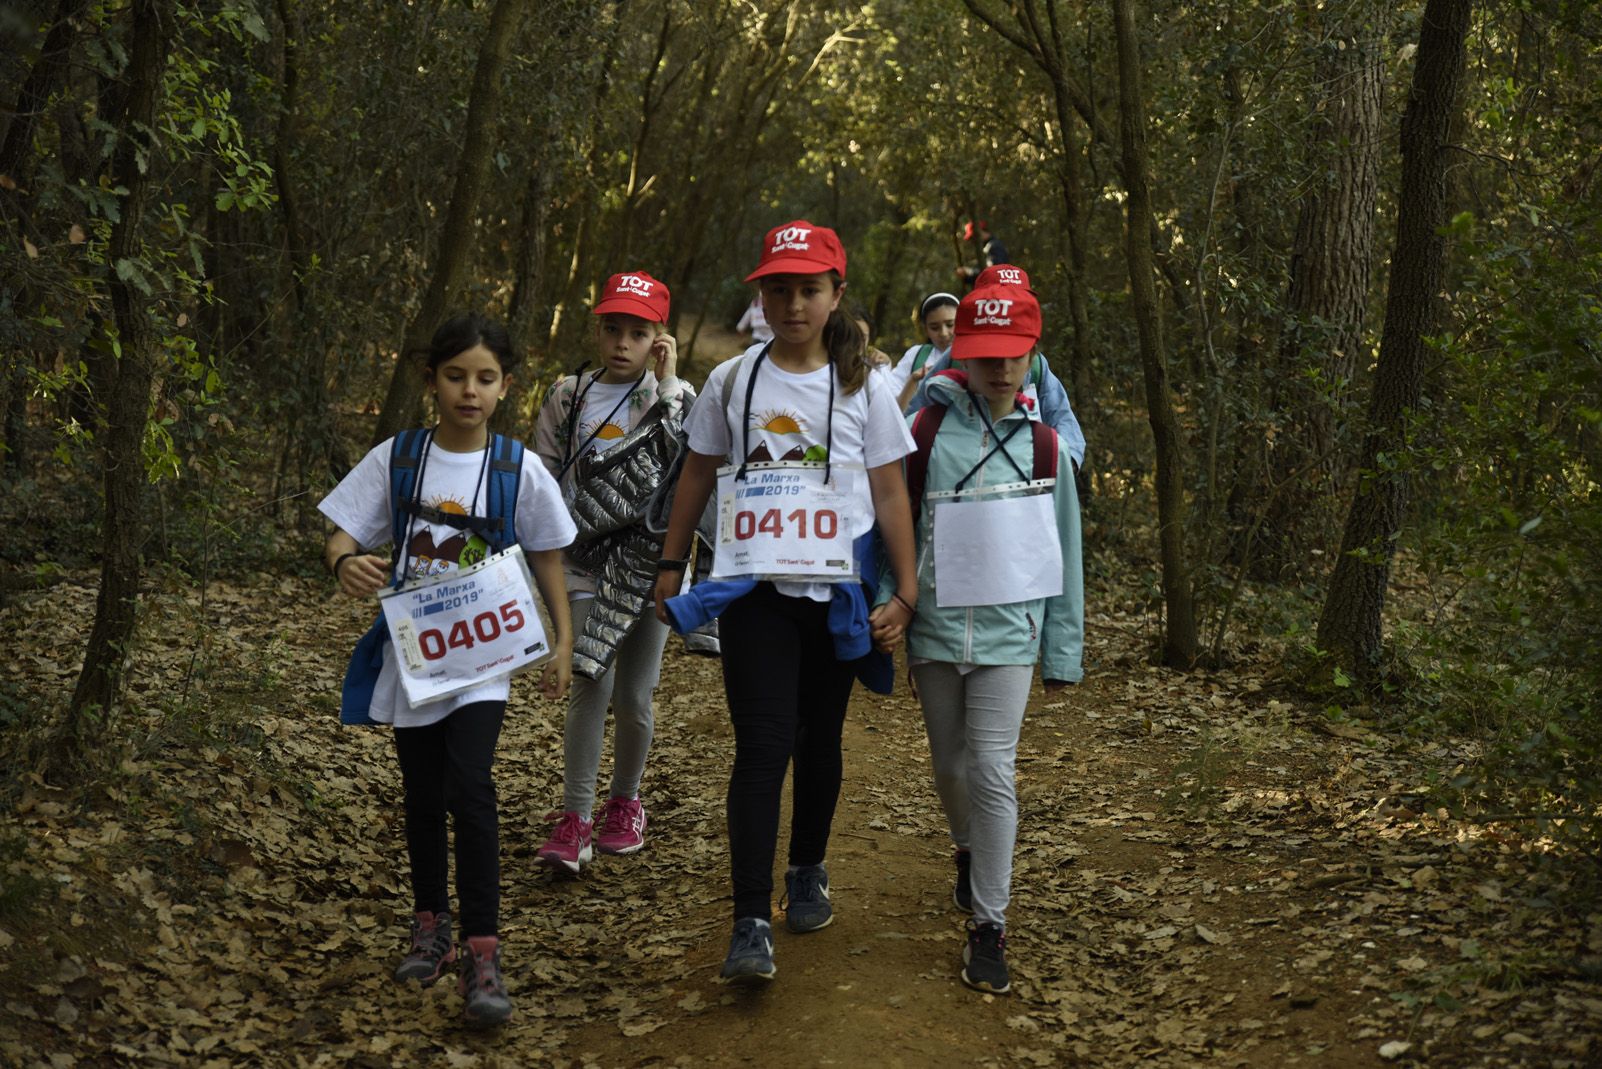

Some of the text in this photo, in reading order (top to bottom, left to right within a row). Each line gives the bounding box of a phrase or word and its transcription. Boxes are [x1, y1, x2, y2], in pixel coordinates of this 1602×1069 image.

[775, 226, 812, 245] TOT
[621, 275, 653, 291] TOT
[997, 269, 1020, 279] TOT
[974, 299, 1013, 316] TOT
[761, 473, 800, 483] Marxa
[735, 508, 838, 541] 0410
[436, 579, 476, 599] Marxa
[418, 599, 525, 661] 0405
